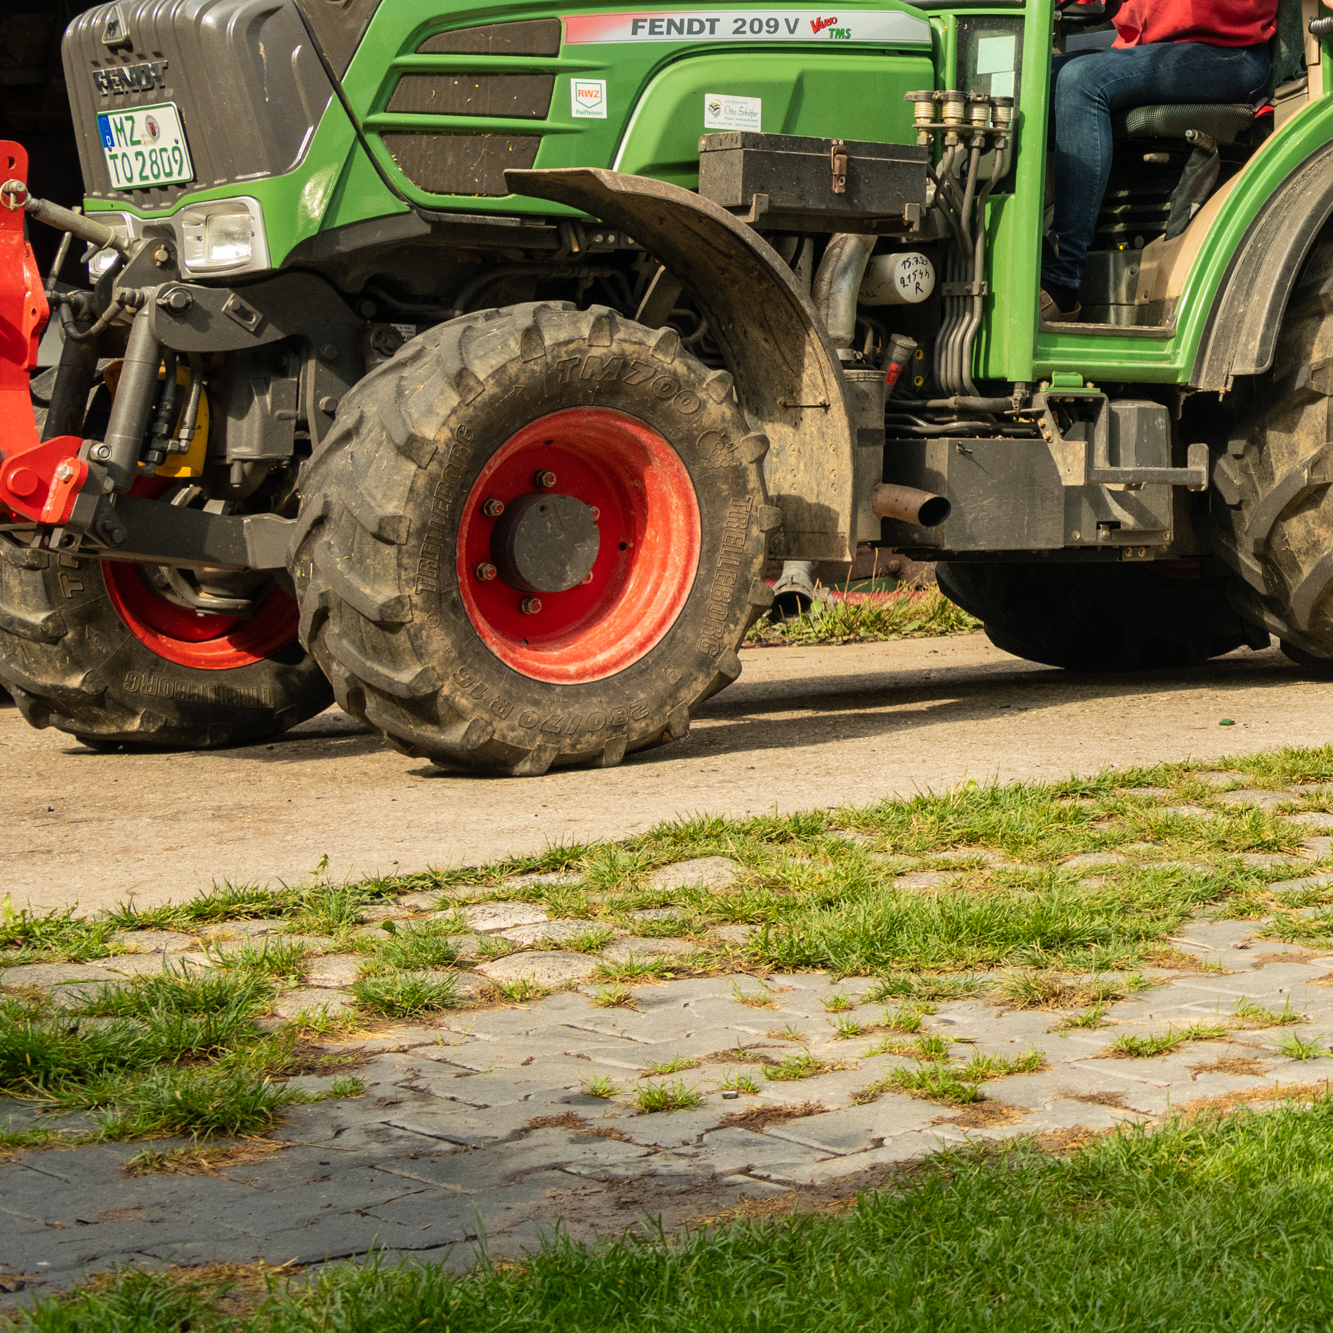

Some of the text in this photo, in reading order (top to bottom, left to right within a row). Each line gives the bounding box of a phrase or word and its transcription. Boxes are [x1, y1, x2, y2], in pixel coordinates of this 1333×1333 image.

[631, 18, 721, 36] FENDT
[732, 17, 780, 35] 209
[828, 28, 852, 40] TMS
[92, 60, 169, 97] FENDT
[577, 89, 600, 99] RWZ
[575, 108, 603, 116] Raiffeisen
[112, 115, 142, 147] MZ
[135, 146, 184, 182] 2809
[915, 281, 924, 295] R
[554, 353, 702, 417] TM700
[414, 422, 474, 596] TRELLEBORG
[699, 494, 755, 657] TRELLEBORG
[123, 671, 275, 709] TRELLEBORG
[489, 696, 514, 720] R
[517, 699, 651, 737] 280/70
